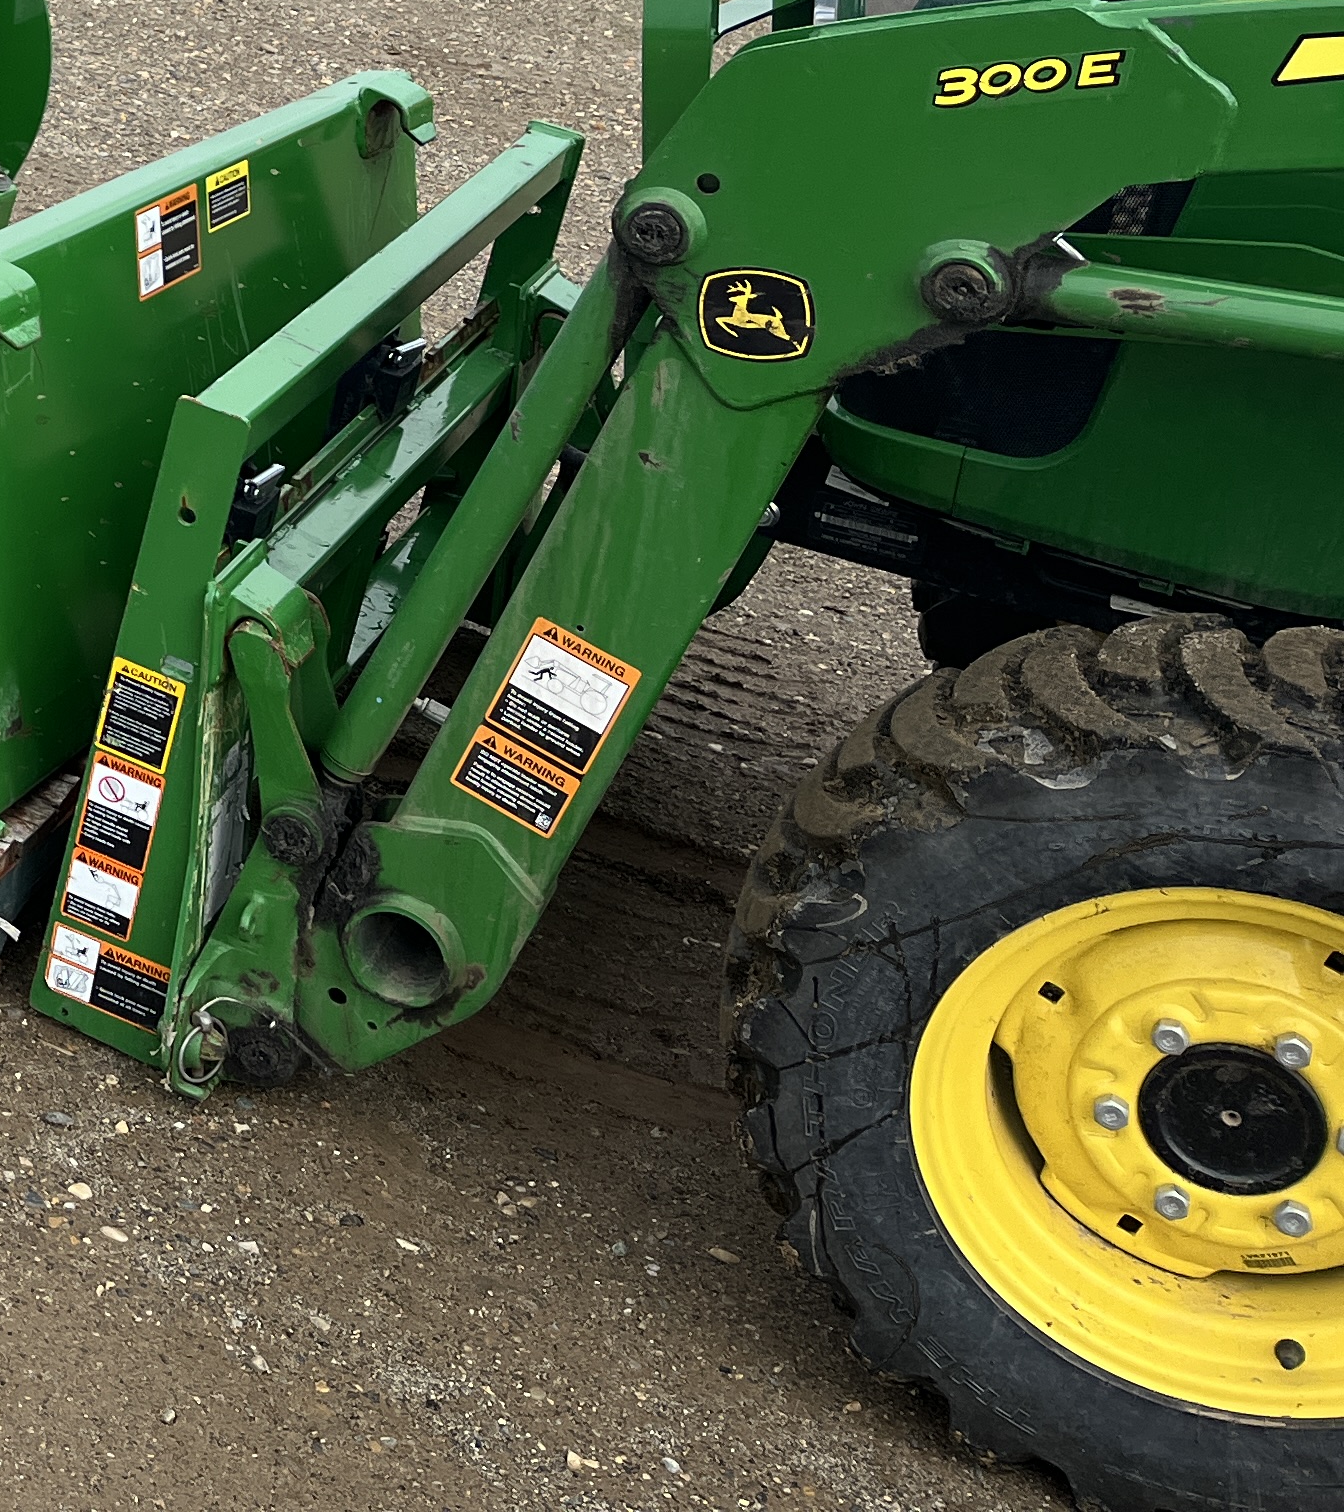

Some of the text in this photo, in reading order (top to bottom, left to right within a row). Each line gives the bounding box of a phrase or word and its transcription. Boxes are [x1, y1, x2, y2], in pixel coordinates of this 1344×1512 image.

[561, 635, 626, 678] WARNING
[129, 667, 177, 693] CAUTION
[110, 760, 162, 788] WARNING
[503, 745, 566, 787] WARNING
[88, 858, 140, 886] WARNING
[115, 952, 170, 982] WARNING
[916, 1335, 1038, 1437] THE
